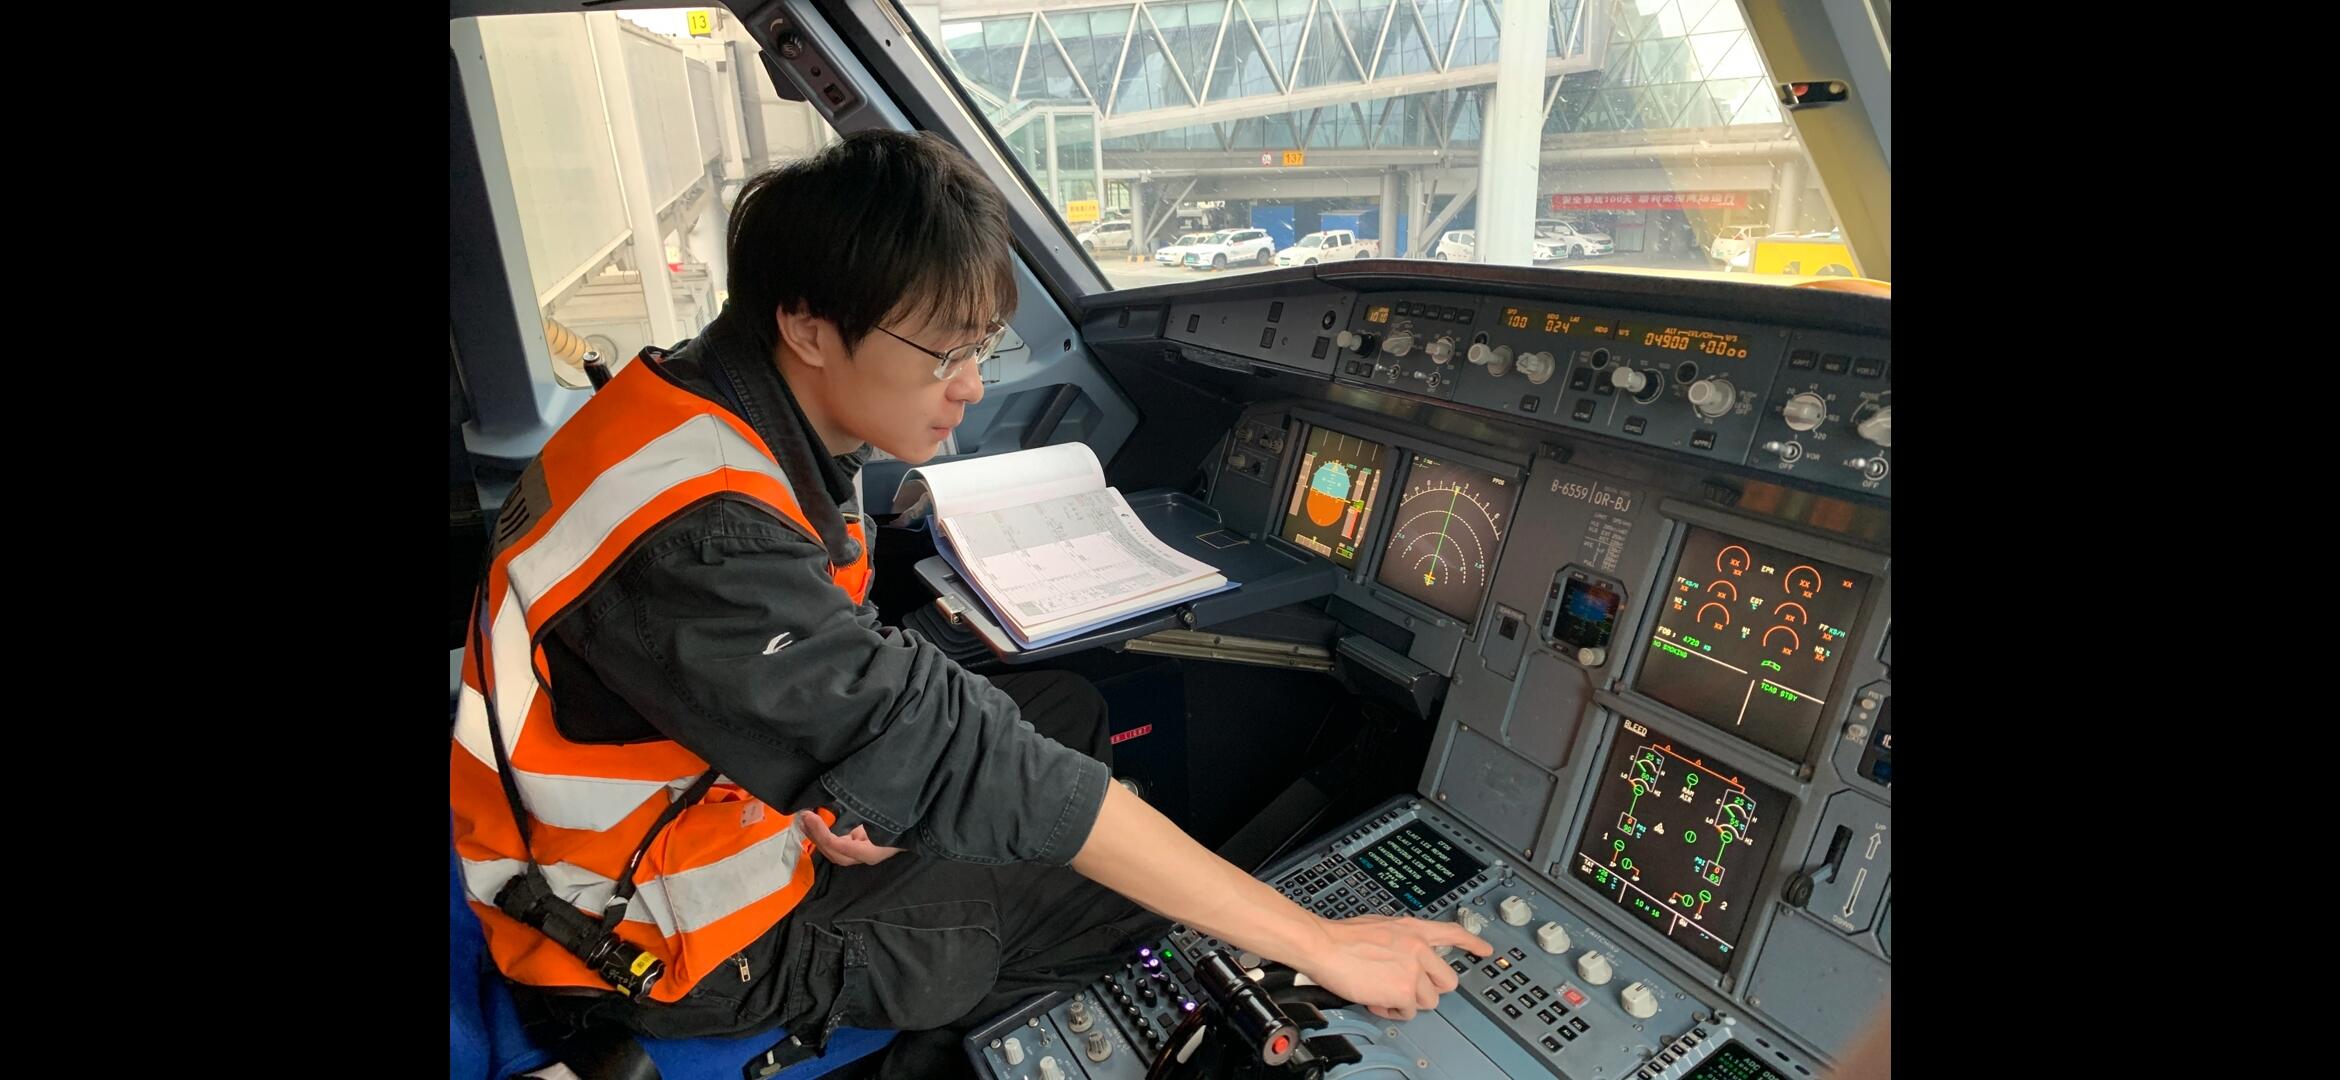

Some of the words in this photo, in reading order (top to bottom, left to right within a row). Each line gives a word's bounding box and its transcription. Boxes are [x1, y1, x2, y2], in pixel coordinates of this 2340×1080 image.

[692, 16, 706, 29] 13
[1286, 153, 1302, 163] 137
[1508, 315, 1528, 328] 100
[1546, 320, 1570, 333] 024
[1644, 332, 1689, 350] 04900
[1806, 452, 1820, 460] VOR
[1551, 479, 1588, 500] B-6559
[1862, 480, 1880, 489] OFF
[1761, 565, 1775, 575] EPR
[1800, 579, 1810, 589] XX
[1843, 580, 1853, 589] XX
[1785, 614, 1796, 622] XX
[1823, 632, 1832, 640] XX
[1782, 647, 1792, 656] XX
[1814, 653, 1825, 662] XX
[1761, 682, 1777, 694] TCAS
[1780, 690, 1798, 702] STBY
[1624, 720, 1648, 736] BLEED
[1734, 796, 1745, 806] 25
[1431, 848, 1451, 862] REPORT
[1435, 863, 1455, 878] REPORT
[1388, 866, 1407, 880] REPORT
[1411, 885, 1426, 895] TEST
[1425, 869, 1445, 883] REPORT
[1720, 901, 1728, 910] 2
